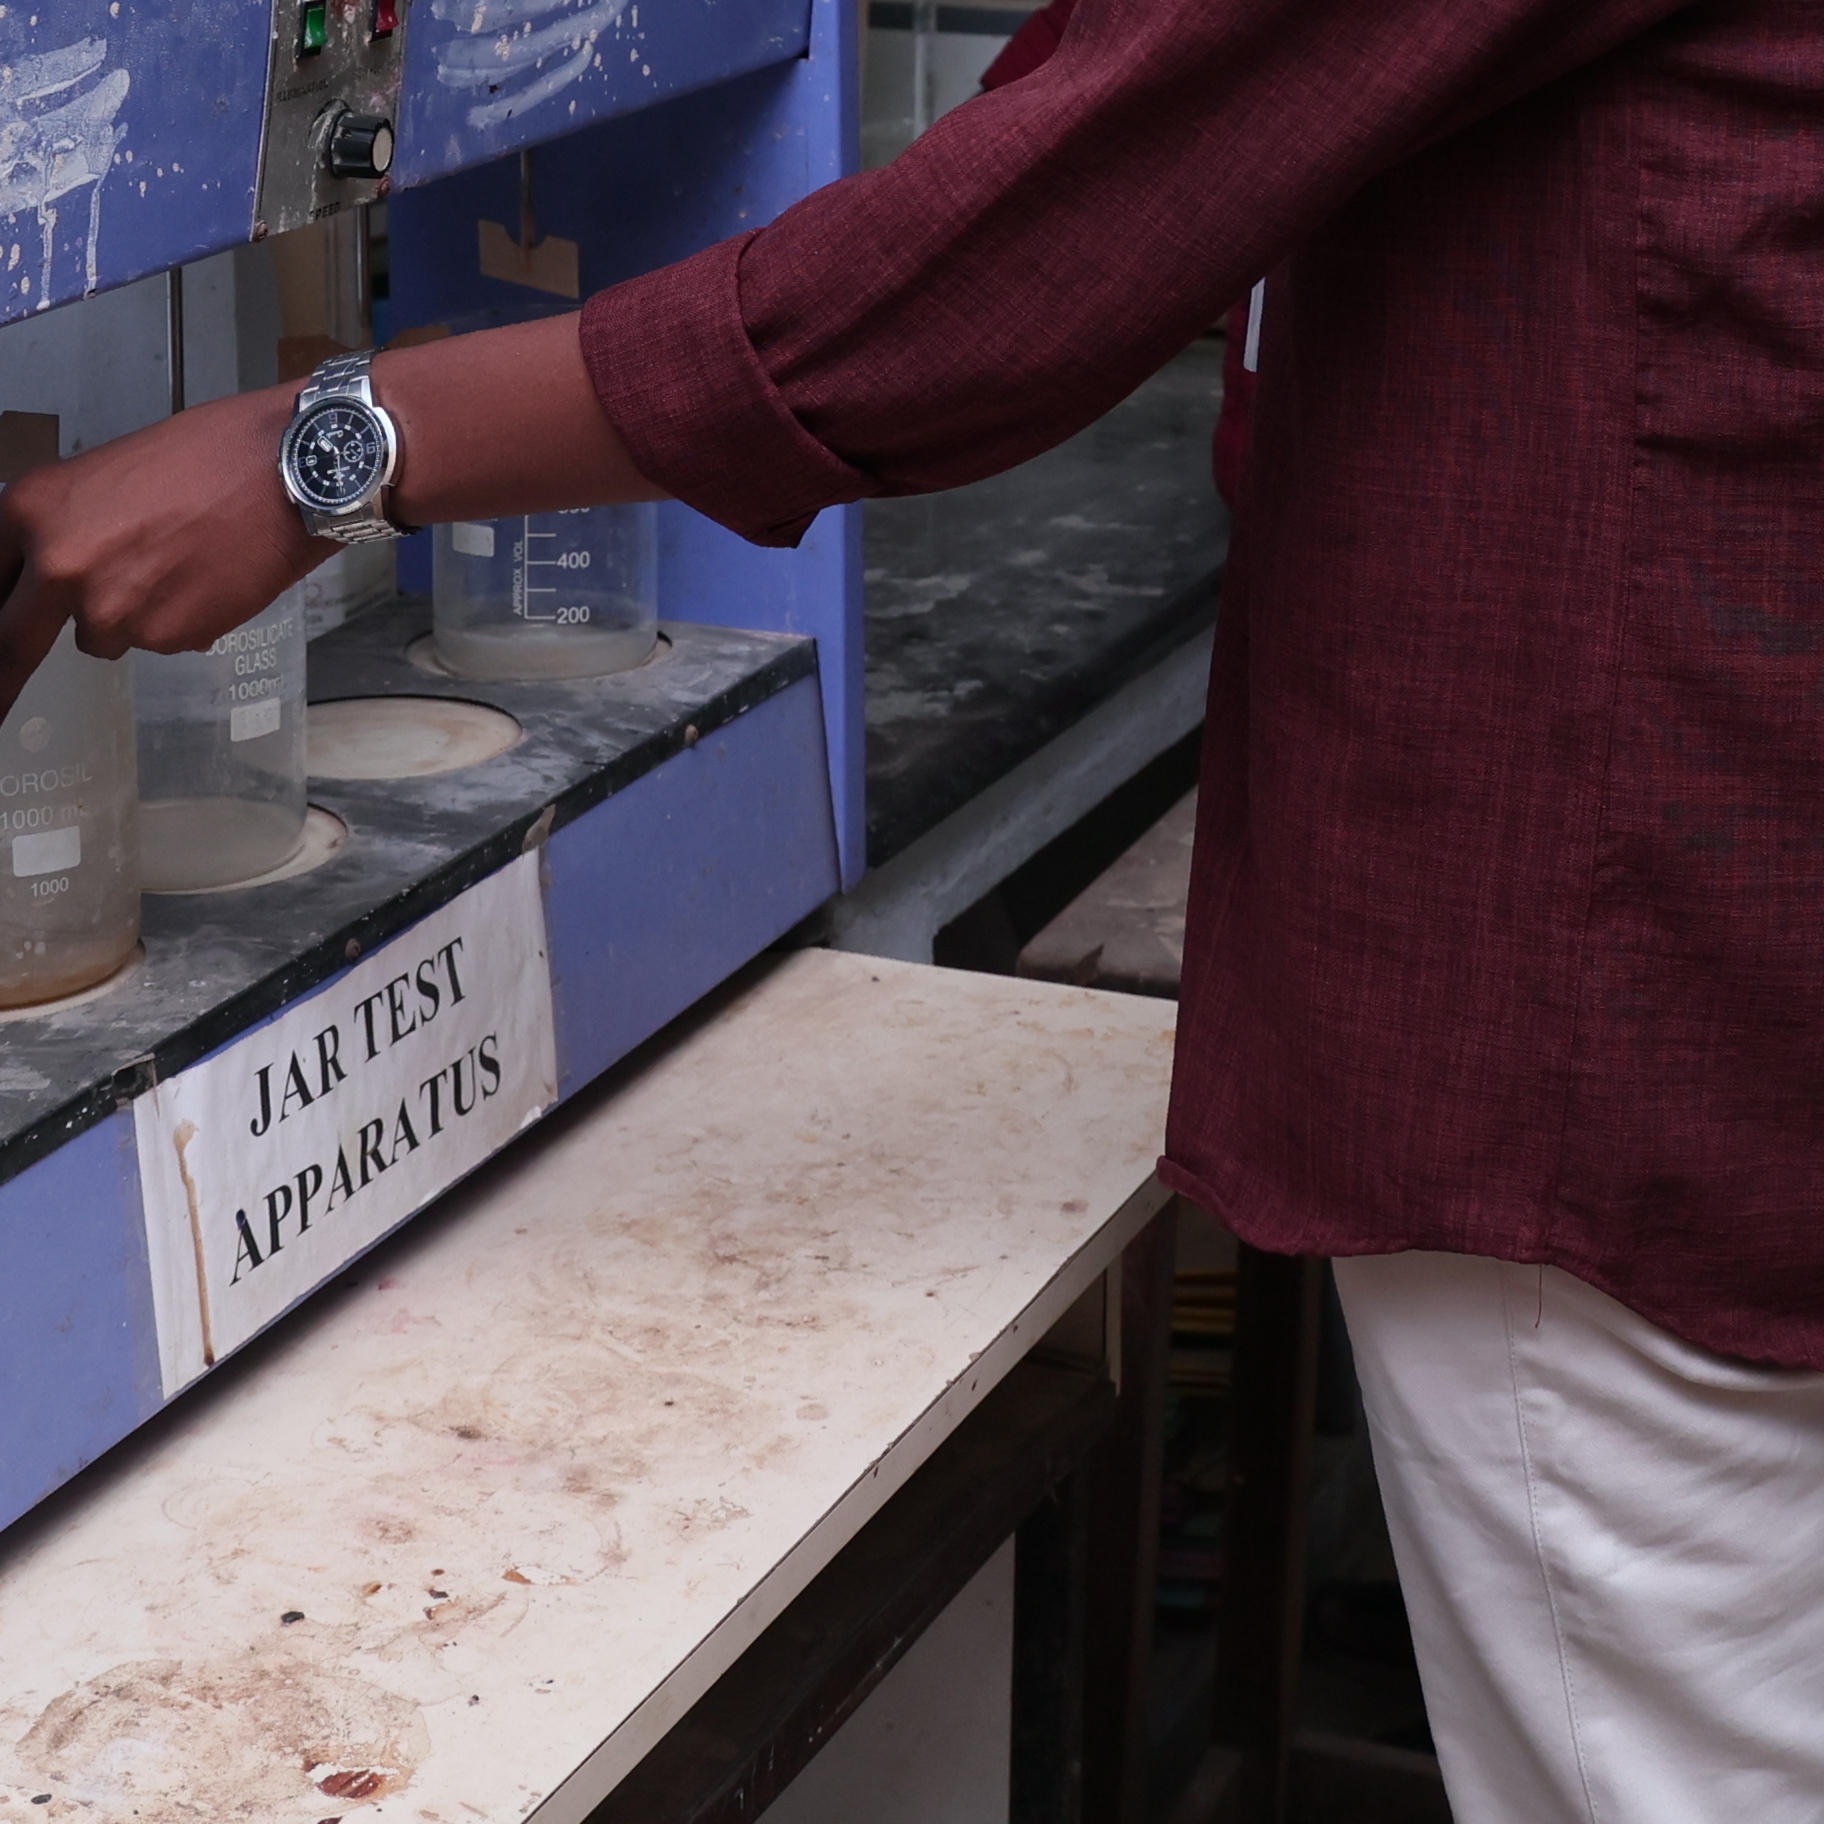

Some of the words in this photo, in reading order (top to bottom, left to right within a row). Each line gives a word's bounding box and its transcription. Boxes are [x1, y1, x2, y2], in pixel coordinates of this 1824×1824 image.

[309, 201, 340, 221] PEED
[556, 550, 591, 570] 400
[512, 567, 524, 616] APPROX
[556, 606, 591, 624] 200
[235, 648, 276, 676] GLASS
[0, 805, 53, 831] 1000
[30, 876, 69, 898] 1000
[250, 1025, 348, 1138] JAR
[354, 936, 466, 1063] TEST
[228, 1032, 501, 1287] APPARATUS
